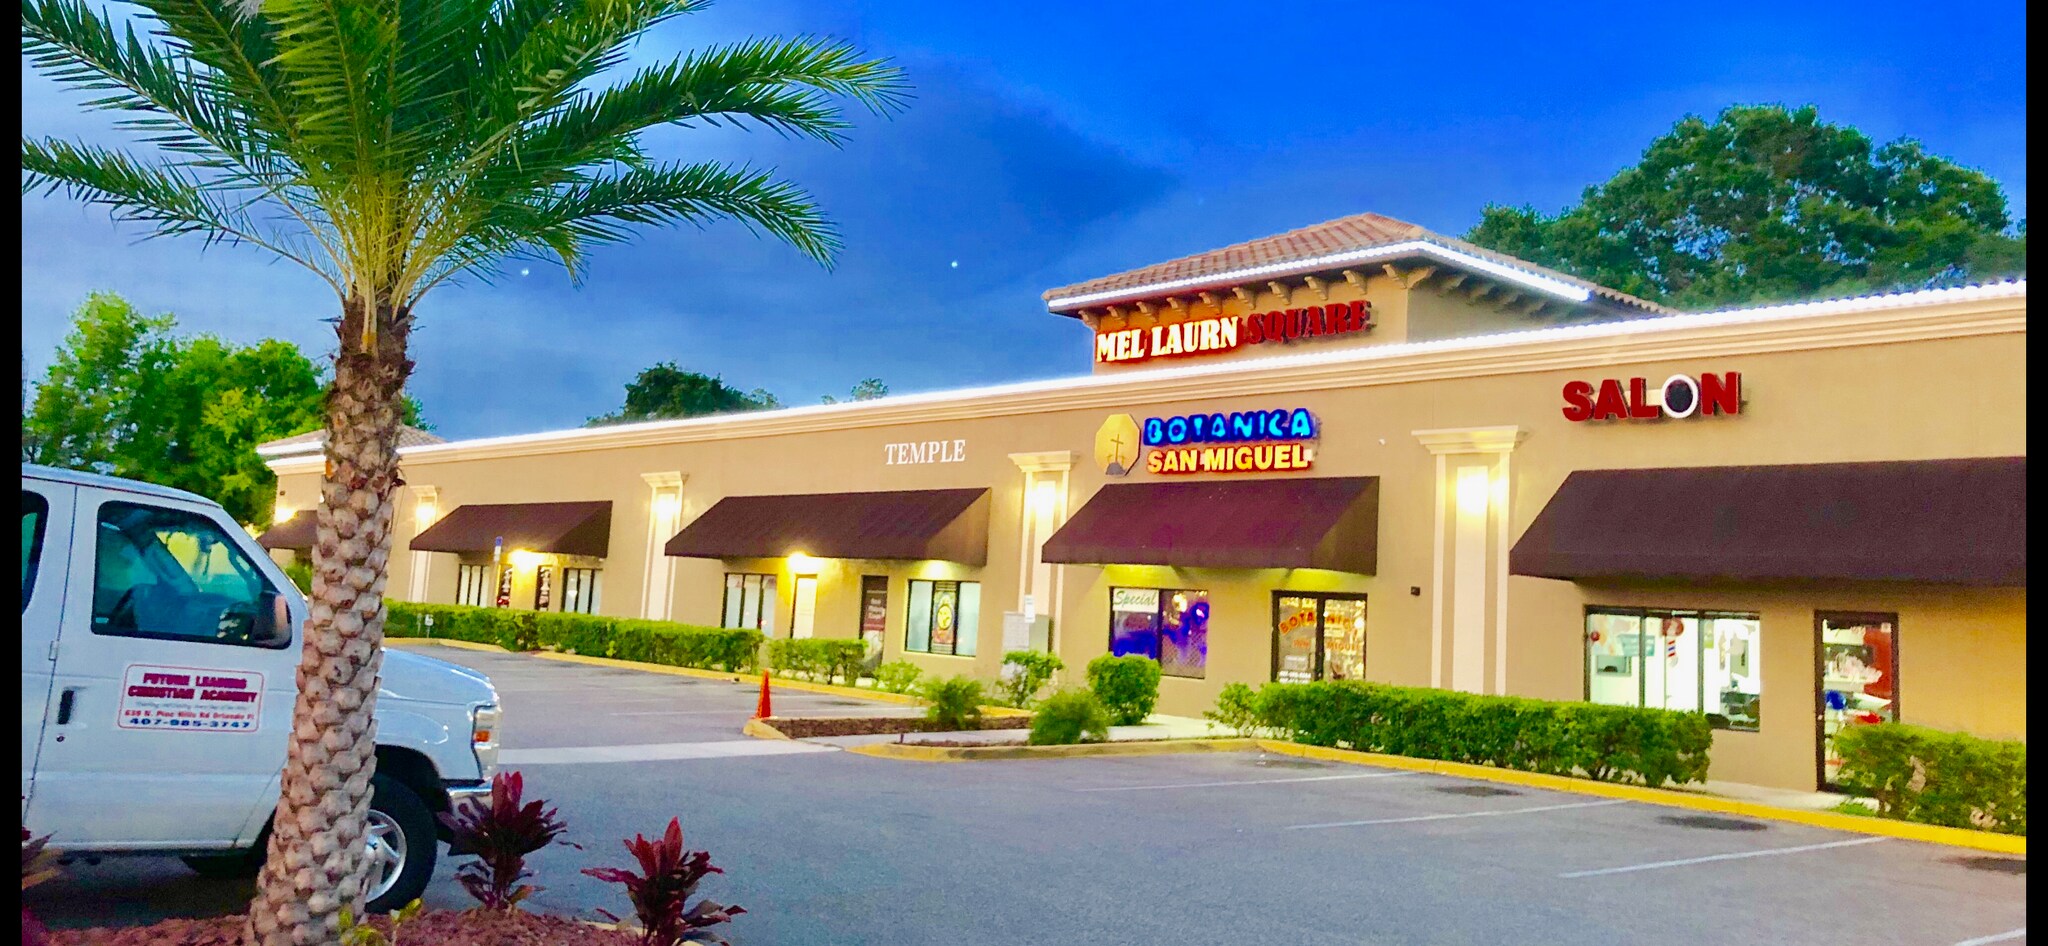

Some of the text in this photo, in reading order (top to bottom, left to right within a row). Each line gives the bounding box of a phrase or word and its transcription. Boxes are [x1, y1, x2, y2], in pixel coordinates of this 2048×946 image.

[1097, 299, 1370, 363] MEL LAURN SQUARE
[1562, 371, 1740, 422] SALON
[1143, 408, 1313, 446] BOTANICA
[884, 439, 966, 465] TEMPLE
[1147, 444, 1311, 474] SAN MIGUEL
[1113, 590, 1157, 608] Special
[200, 690, 258, 703] ACADEMY
